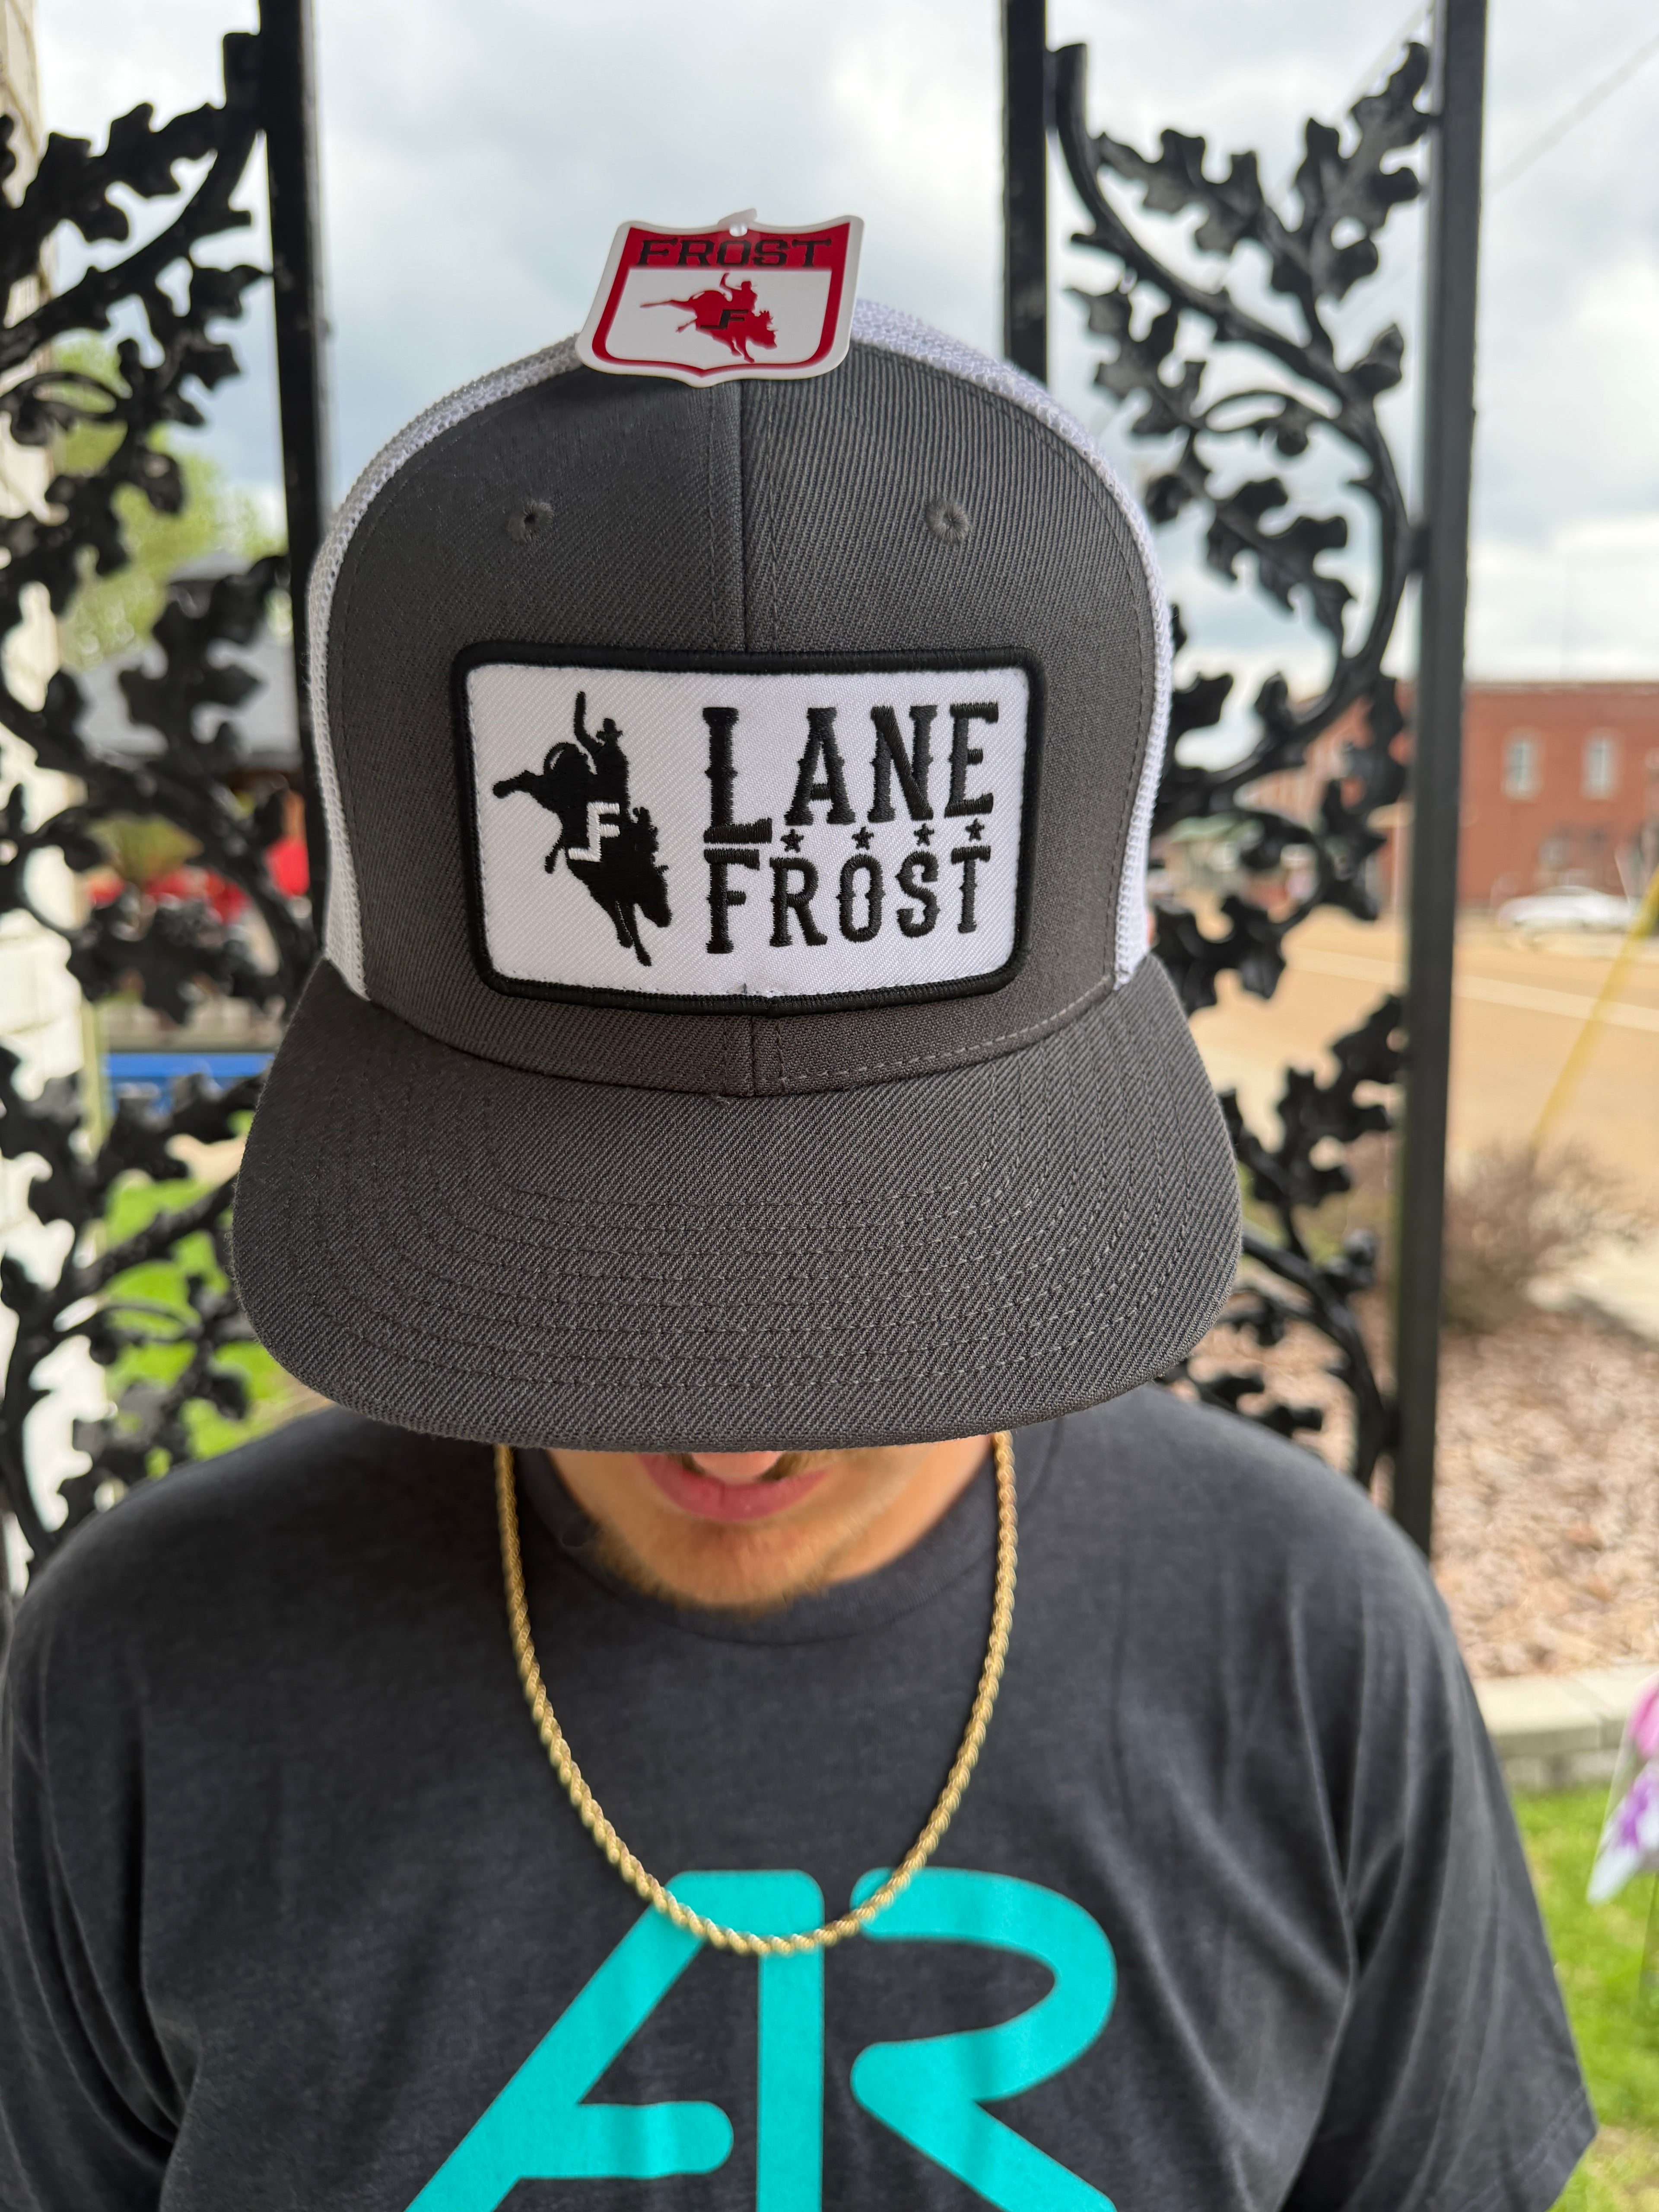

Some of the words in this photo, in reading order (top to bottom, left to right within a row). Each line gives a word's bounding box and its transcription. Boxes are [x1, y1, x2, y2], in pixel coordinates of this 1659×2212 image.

[636, 237, 833, 267] FROST
[702, 701, 999, 845] LANE
[703, 845, 991, 954] FROST
